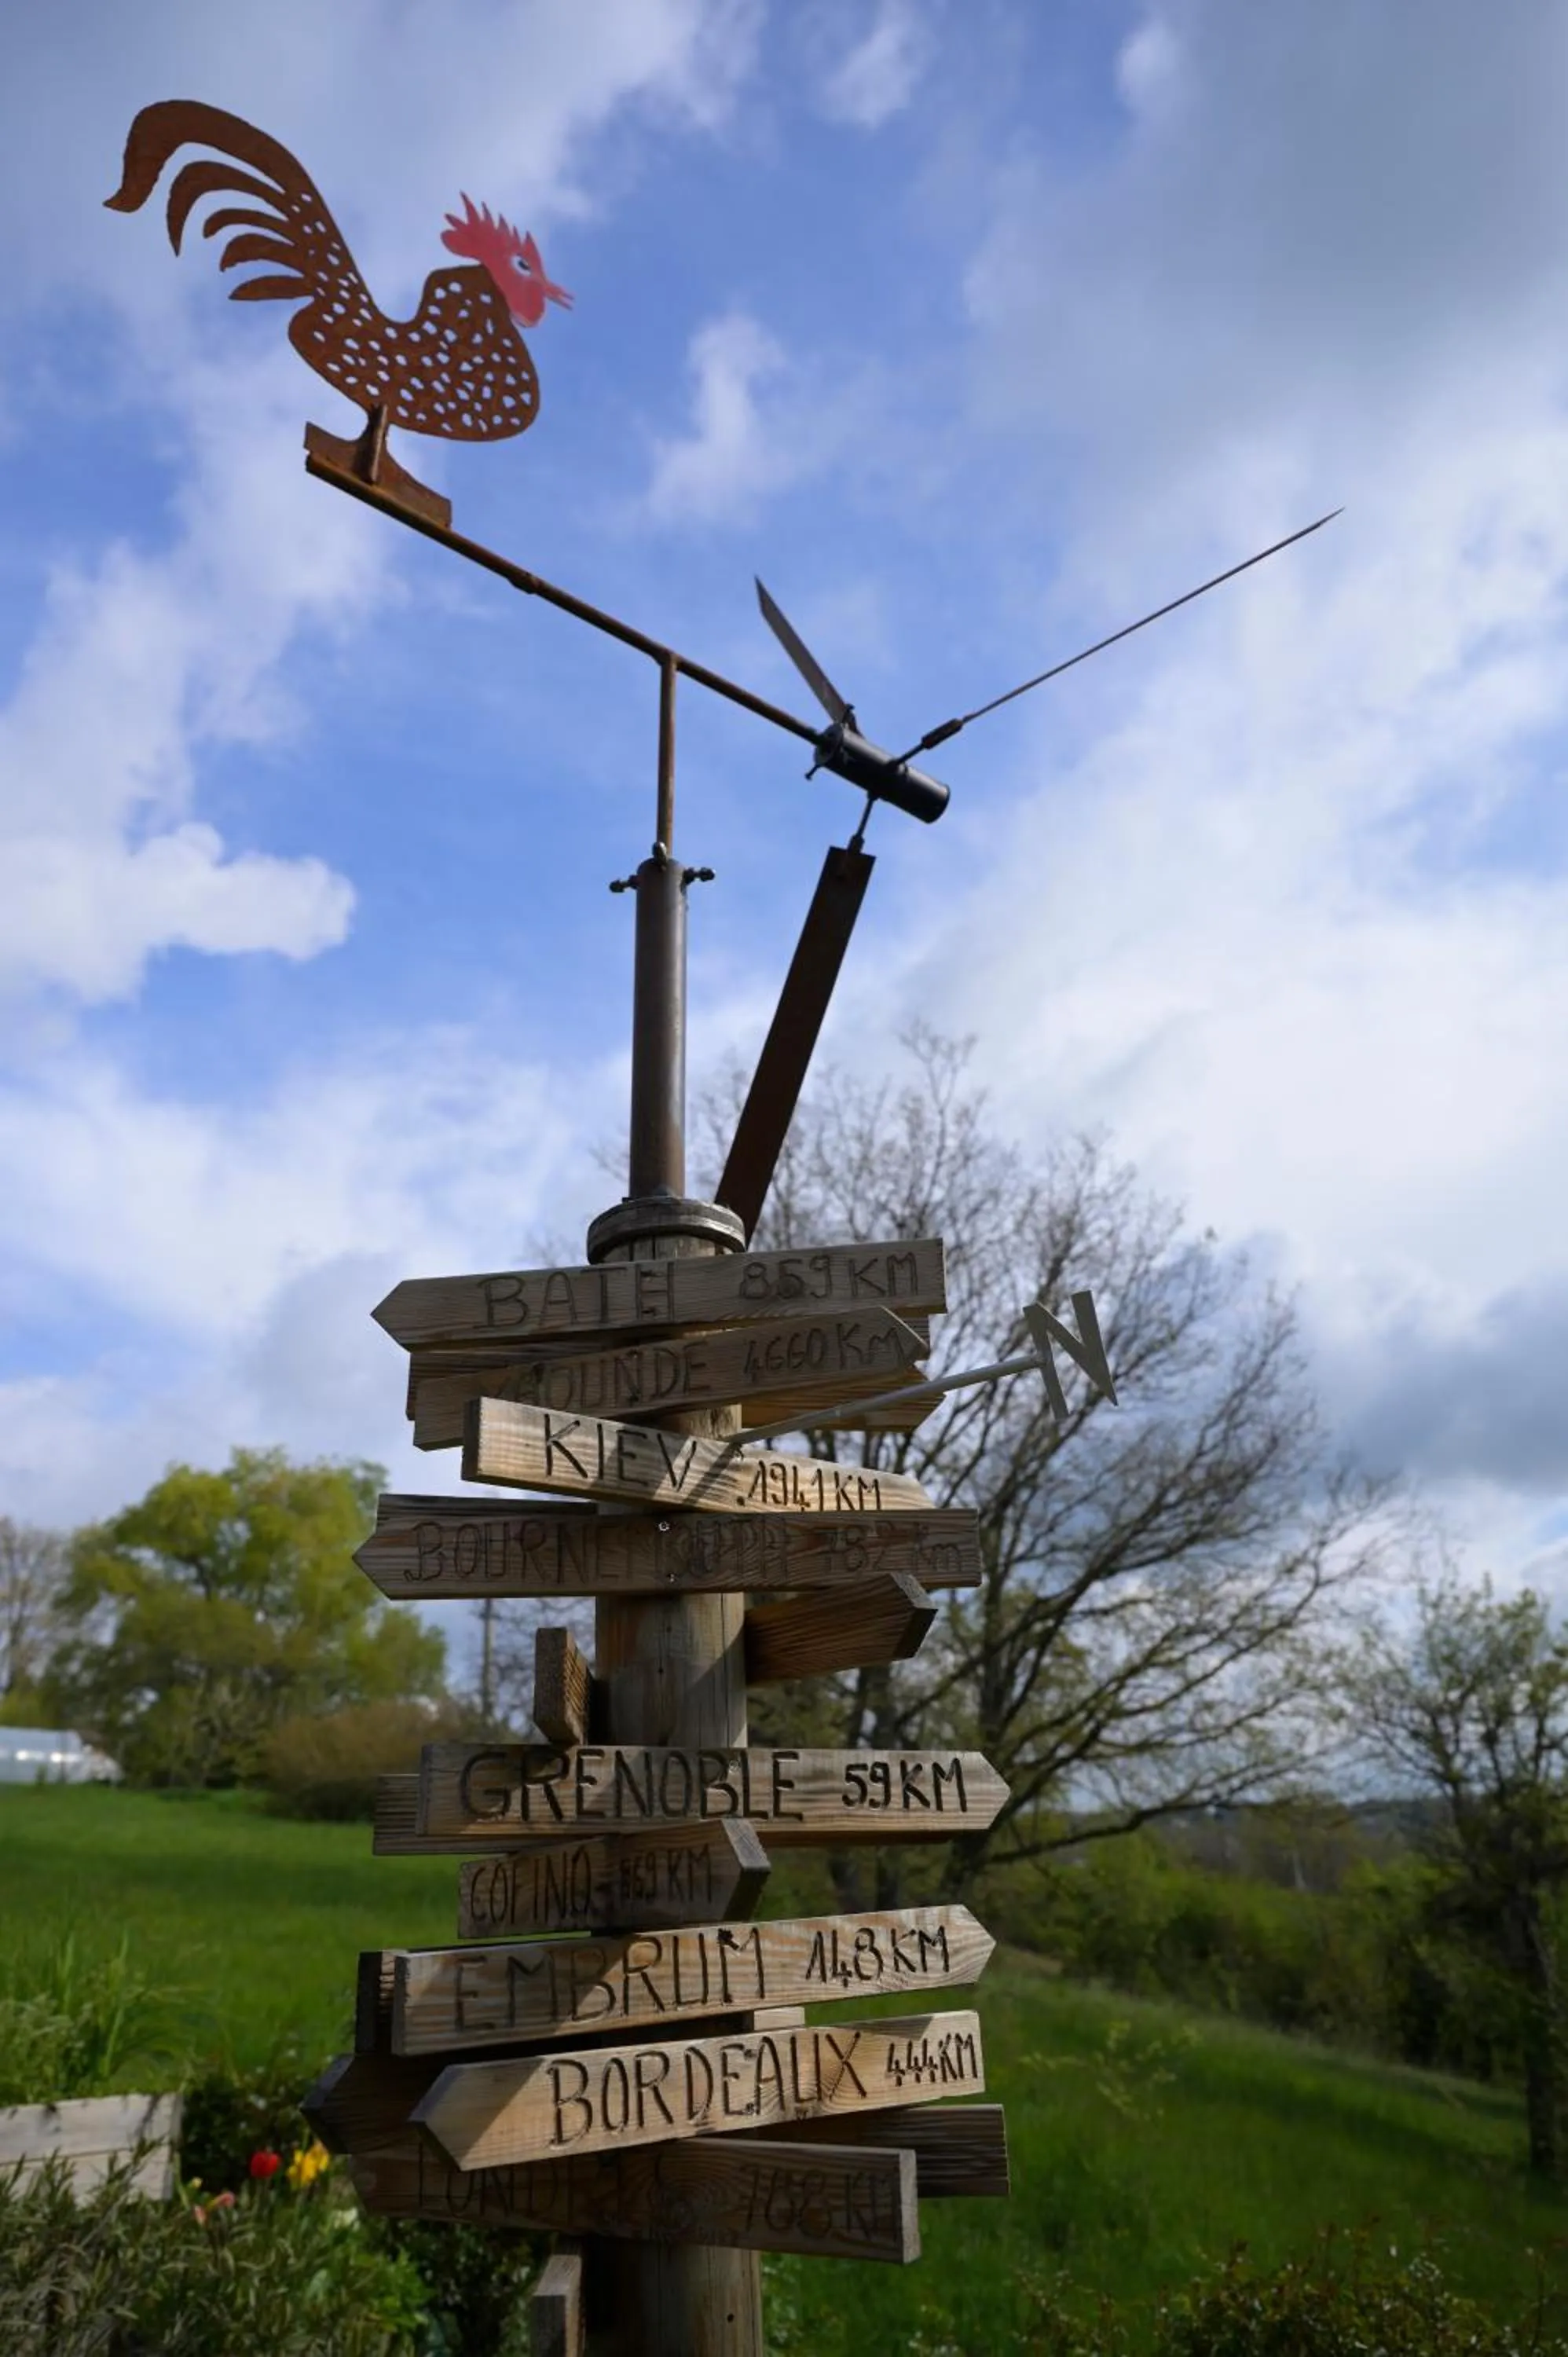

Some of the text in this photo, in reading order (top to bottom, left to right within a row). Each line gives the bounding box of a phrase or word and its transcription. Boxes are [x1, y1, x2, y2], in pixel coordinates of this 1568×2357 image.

[477, 1261, 676, 1329] BATH
[1023, 1289, 1119, 1420] N
[544, 1414, 697, 1491] KIEV
[460, 1749, 804, 1822] GRENOBLE
[548, 2033, 867, 2150] BORDEAUX
